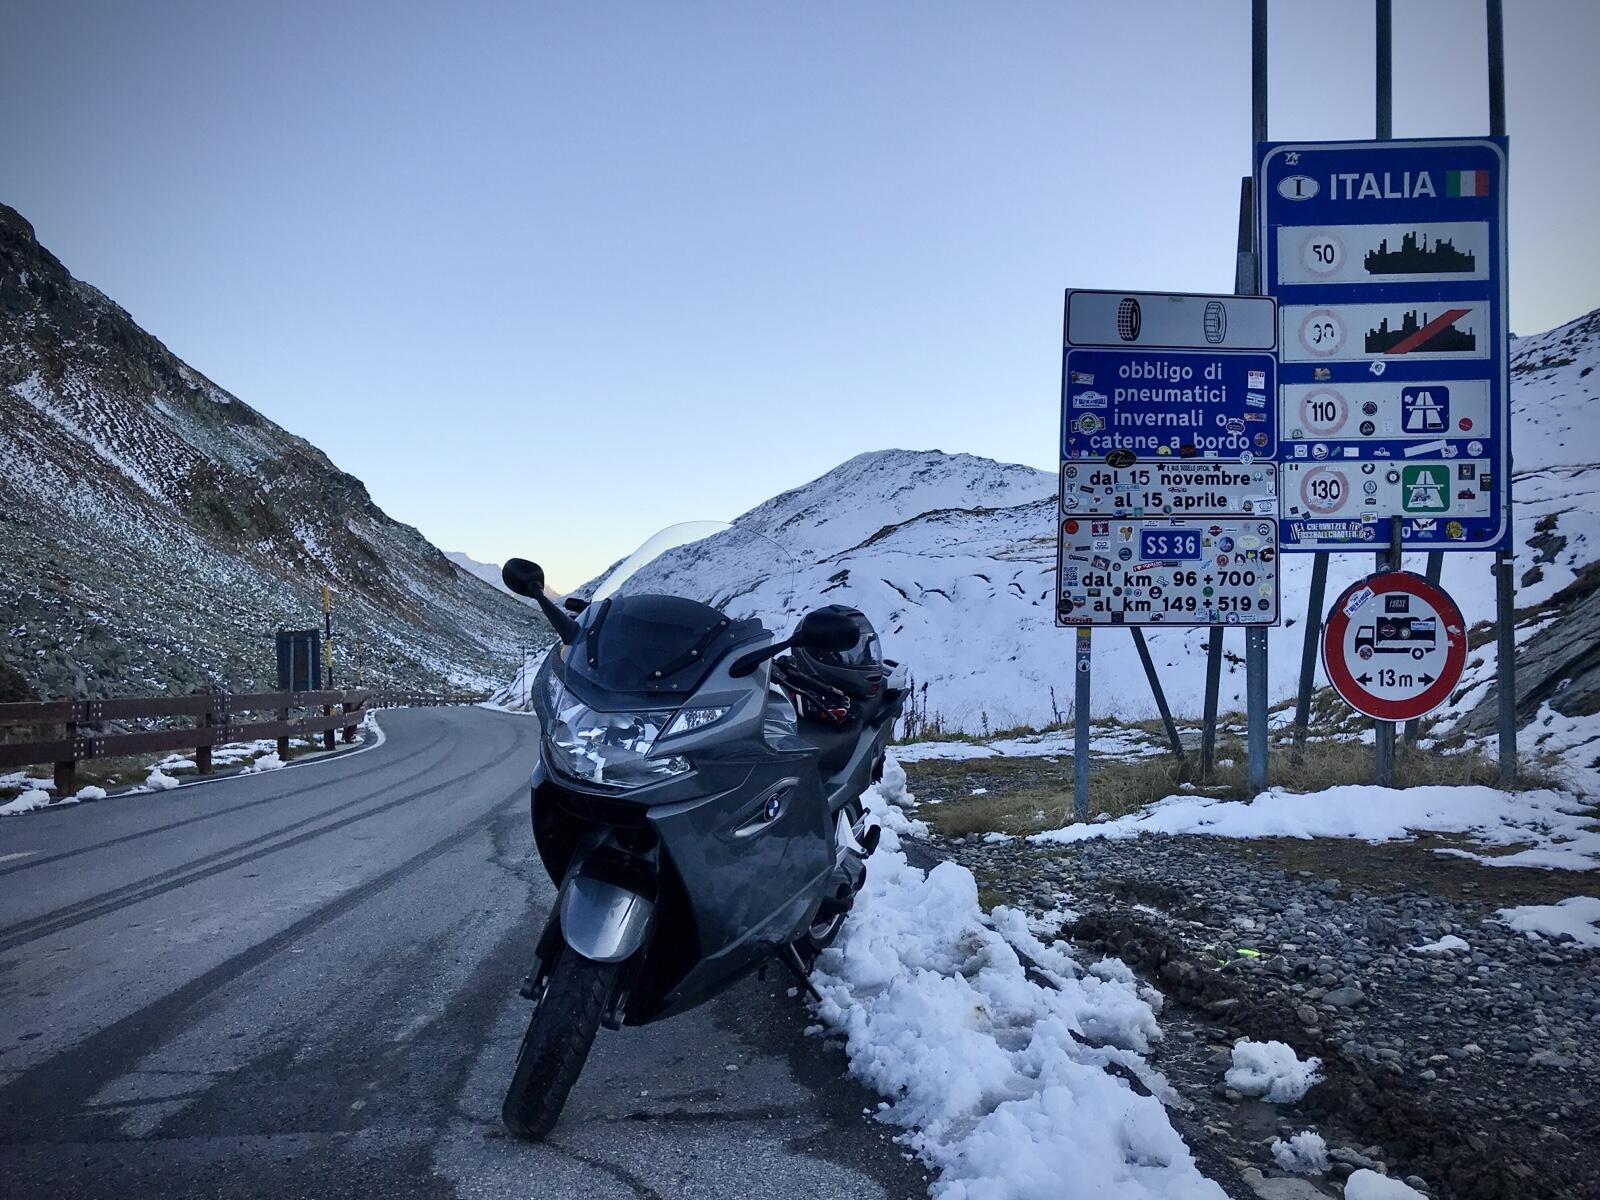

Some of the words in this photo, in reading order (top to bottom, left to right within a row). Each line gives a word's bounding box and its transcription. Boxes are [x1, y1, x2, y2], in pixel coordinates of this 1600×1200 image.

[1294, 179, 1305, 197] I
[1330, 171, 1437, 201] ITALIA
[1118, 361, 1193, 382] obbligo
[1204, 362, 1222, 380] di
[1114, 385, 1227, 404] pneumatici
[1114, 408, 1204, 427] invernali
[1215, 413, 1227, 427] o
[1312, 401, 1336, 421] 110
[1089, 432, 1159, 450] catene
[1169, 437, 1181, 449] a
[1193, 431, 1251, 450] bordo
[1089, 470, 1119, 486] dal
[1129, 470, 1150, 486] 15
[1160, 470, 1251, 486] novembre
[1311, 479, 1341, 500] 130
[1114, 492, 1133, 508] al
[1142, 492, 1163, 508] 15
[1172, 492, 1228, 511] aprile
[1146, 535, 1168, 555] SS
[1173, 535, 1196, 555] 36
[1082, 571, 1114, 587] dal
[1123, 571, 1152, 587] km
[1093, 597, 1113, 612] al
[1123, 597, 1151, 612] km
[1377, 668, 1396, 688] 13
[1398, 673, 1413, 688] m
